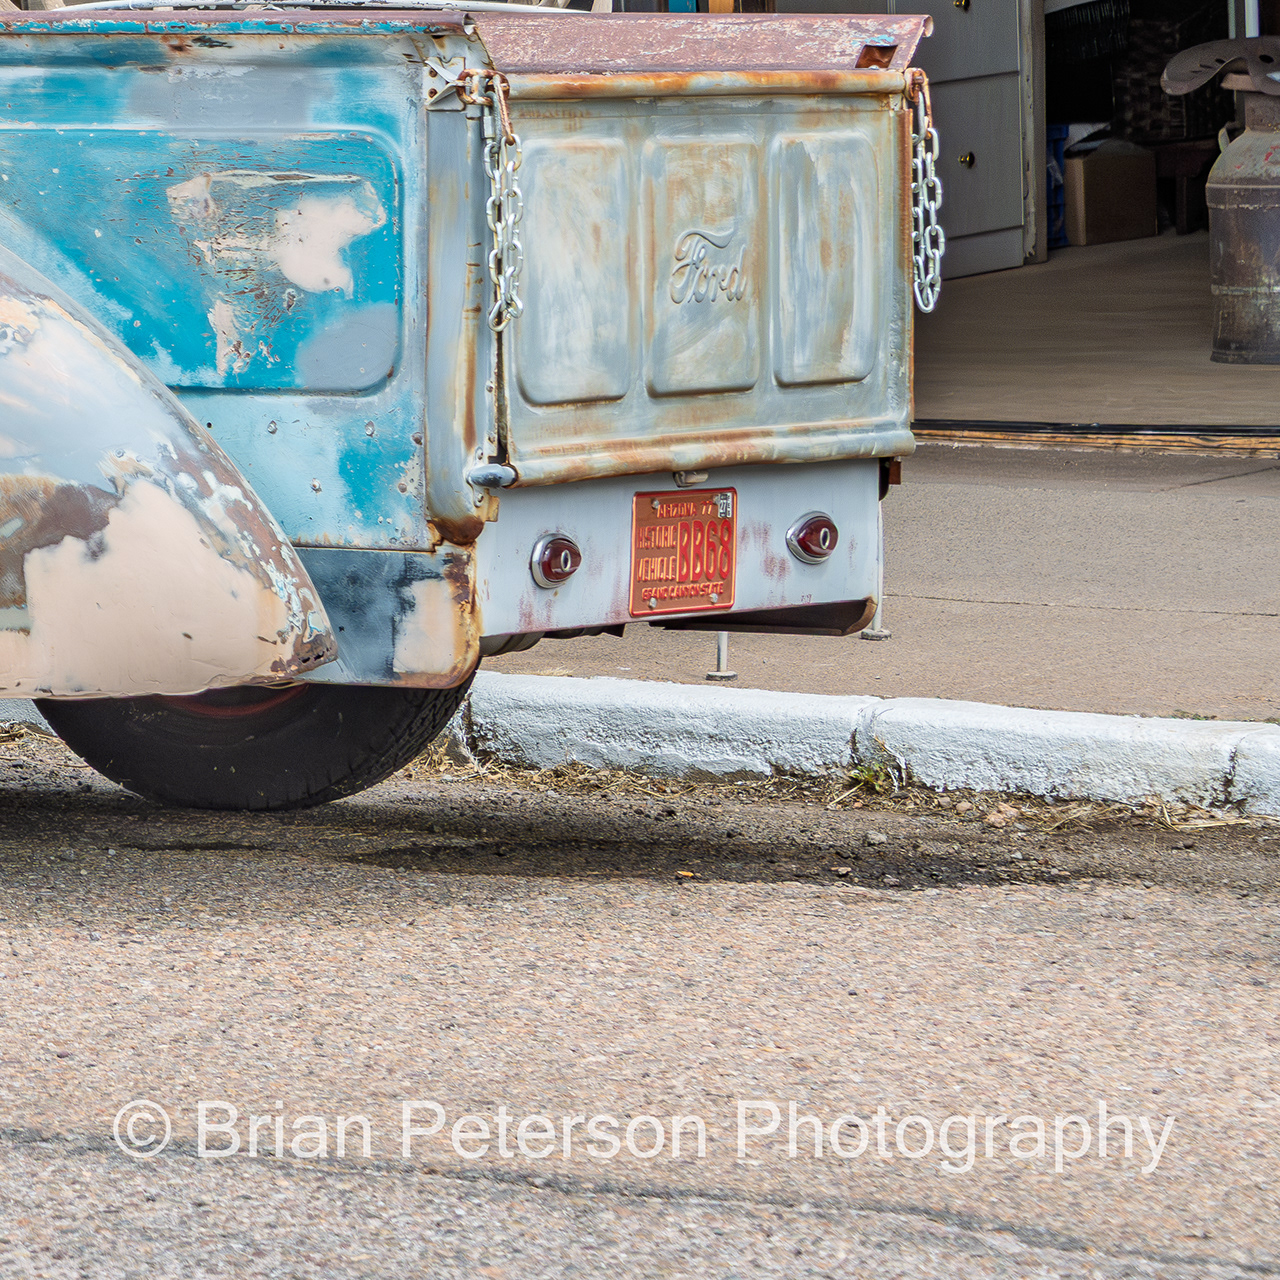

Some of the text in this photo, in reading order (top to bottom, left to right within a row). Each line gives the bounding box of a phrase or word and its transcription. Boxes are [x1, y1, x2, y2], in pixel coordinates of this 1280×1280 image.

[669, 228, 747, 304] Ford
[657, 502, 697, 518] ARIZONA
[637, 519, 732, 582] HISTORIC BB68
[637, 556, 677, 581] VEHICLE
[642, 582, 724, 600] GRAND CANYON STATE
